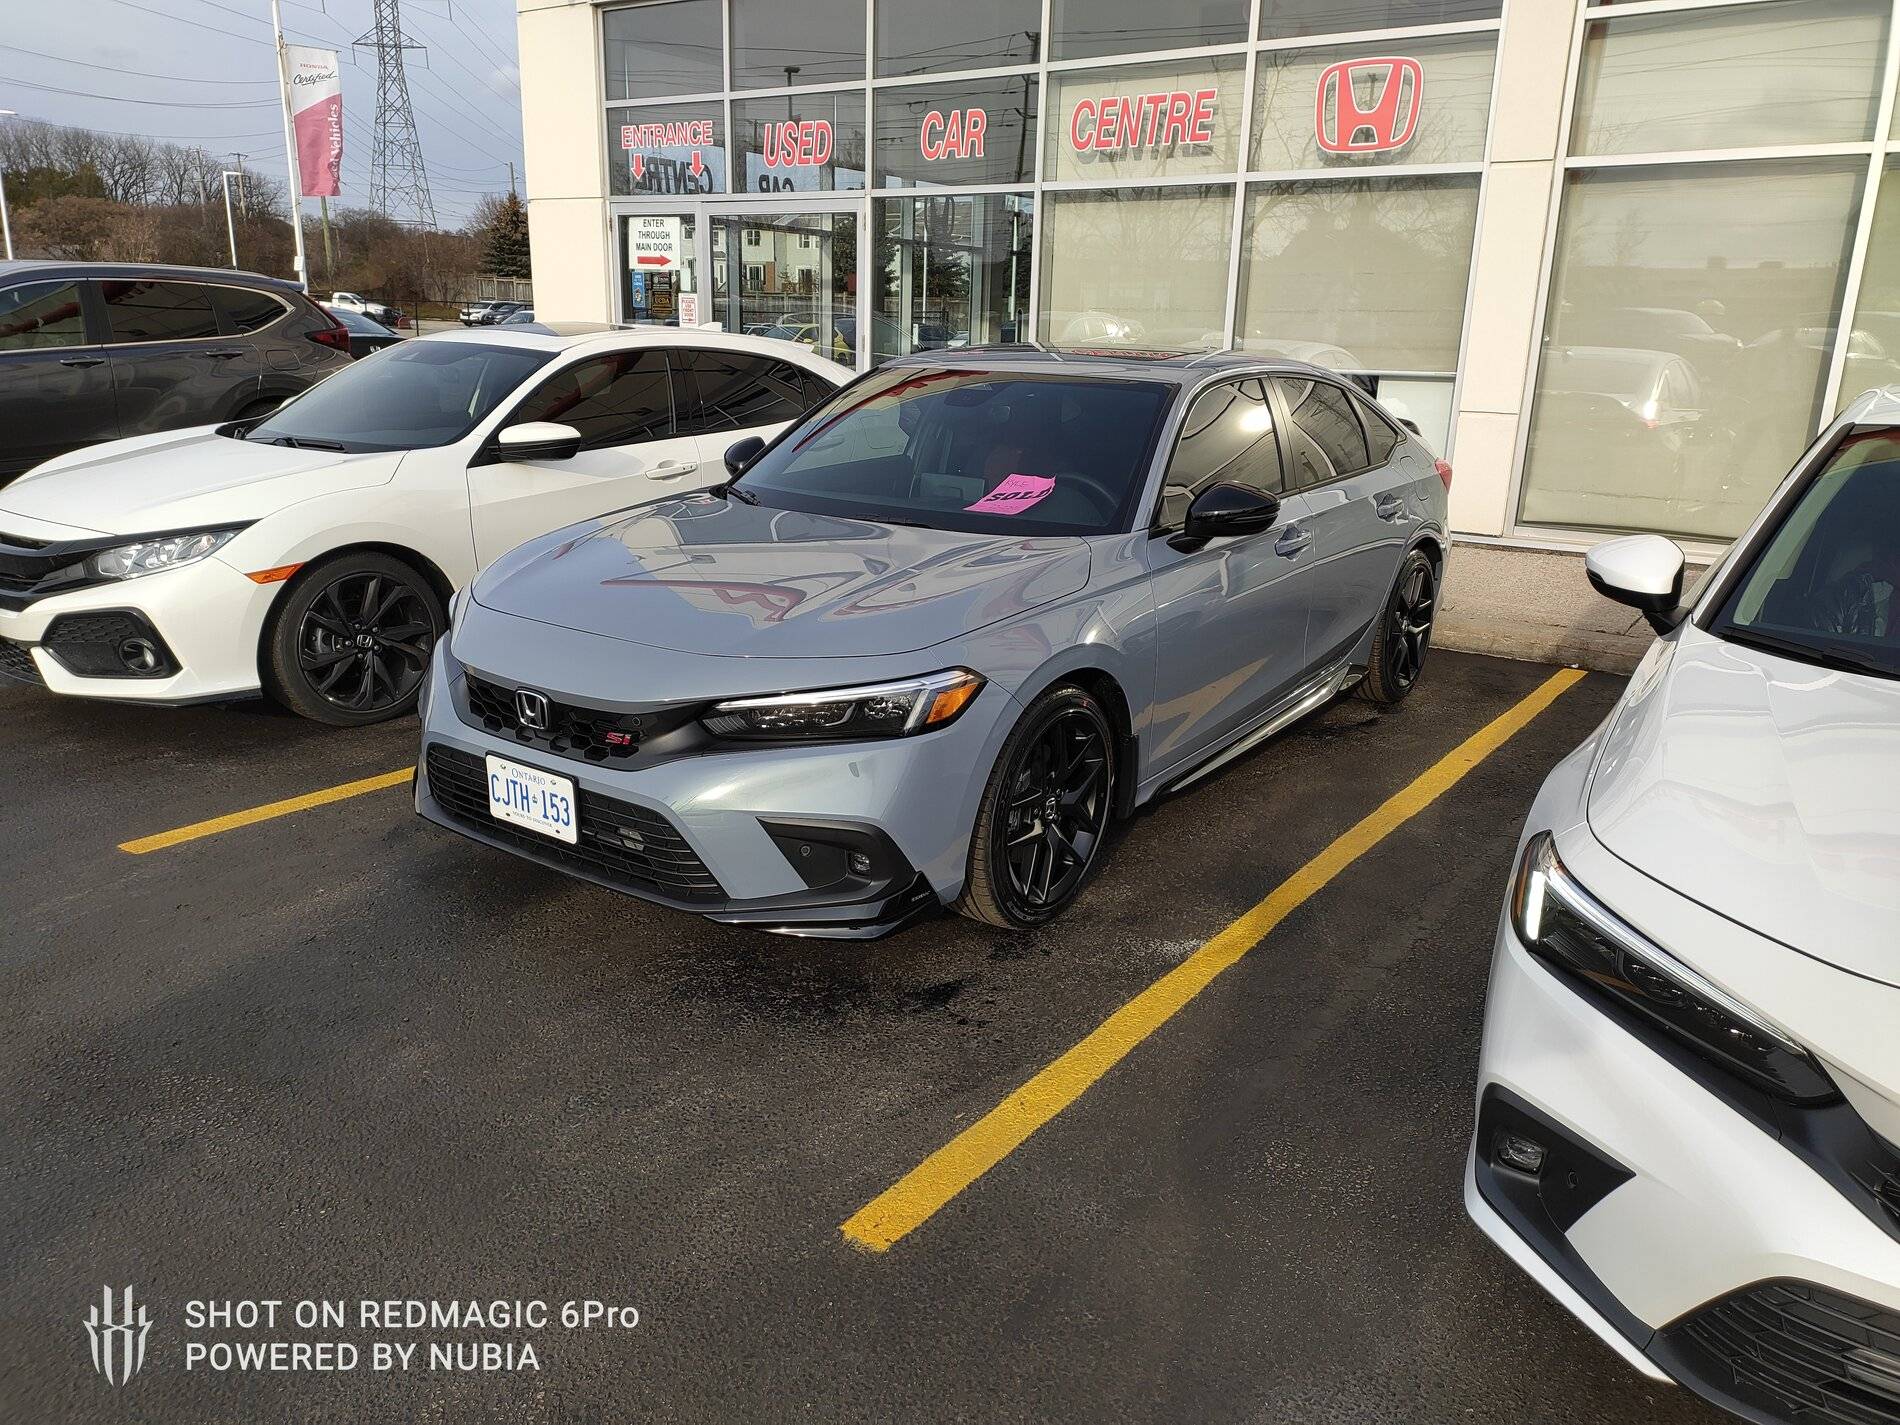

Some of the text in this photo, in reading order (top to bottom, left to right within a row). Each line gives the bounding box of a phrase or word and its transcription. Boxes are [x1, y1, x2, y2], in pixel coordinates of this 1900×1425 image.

[293, 70, 339, 86] Certified
[328, 103, 341, 158] Vehicles
[621, 120, 714, 149] ENTRANCE
[763, 88, 1218, 168] USED CAR CENTRE
[642, 218, 665, 228] ENTER
[638, 230, 671, 240] THROUGH
[635, 242, 673, 252] MAIN DOOR
[983, 484, 1053, 503] SOLD
[511, 767, 546, 787] ONTARIO
[490, 773, 571, 827] CJTH 153
